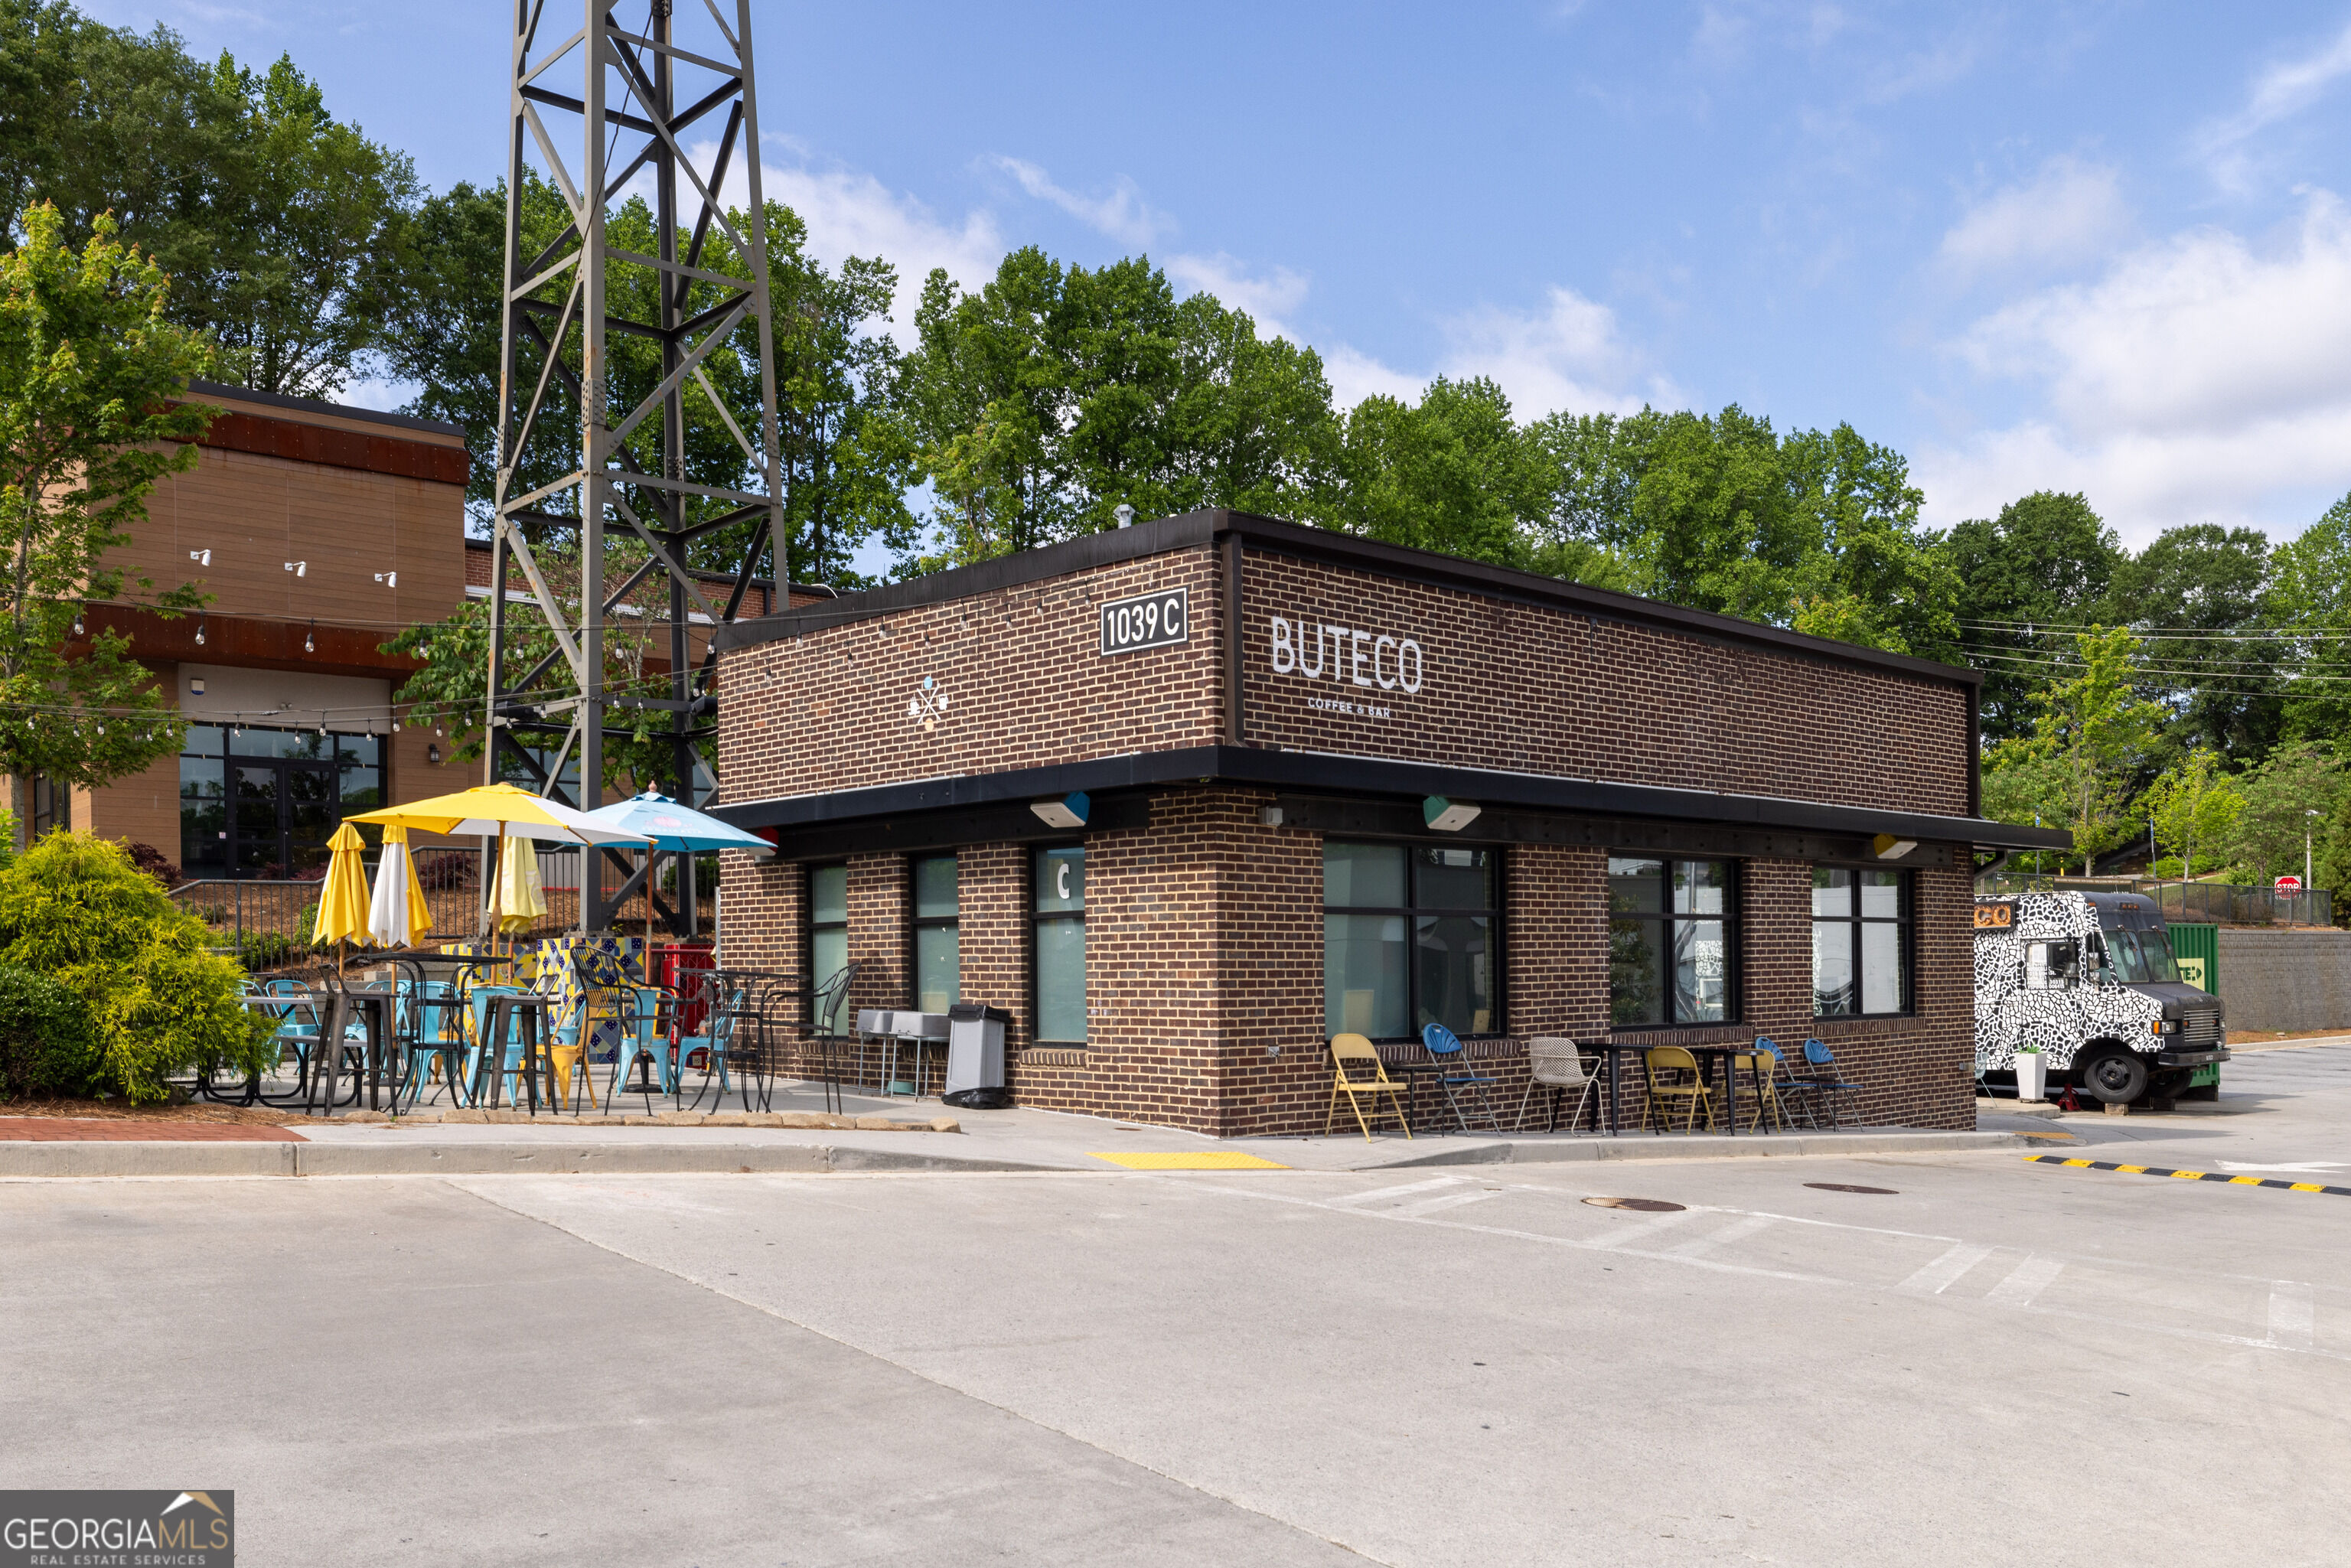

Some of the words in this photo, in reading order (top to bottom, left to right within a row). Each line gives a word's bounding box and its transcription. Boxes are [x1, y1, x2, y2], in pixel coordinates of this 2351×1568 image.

[1107, 602, 1158, 646] 1039
[1164, 598, 1179, 635] C
[1273, 615, 1422, 693] BUTECO
[1308, 696, 1352, 713] COFFEE
[1357, 703, 1364, 714] &
[1368, 706, 1391, 718] BAR
[1057, 863, 1070, 899] C
[2277, 883, 2299, 892] STOP
